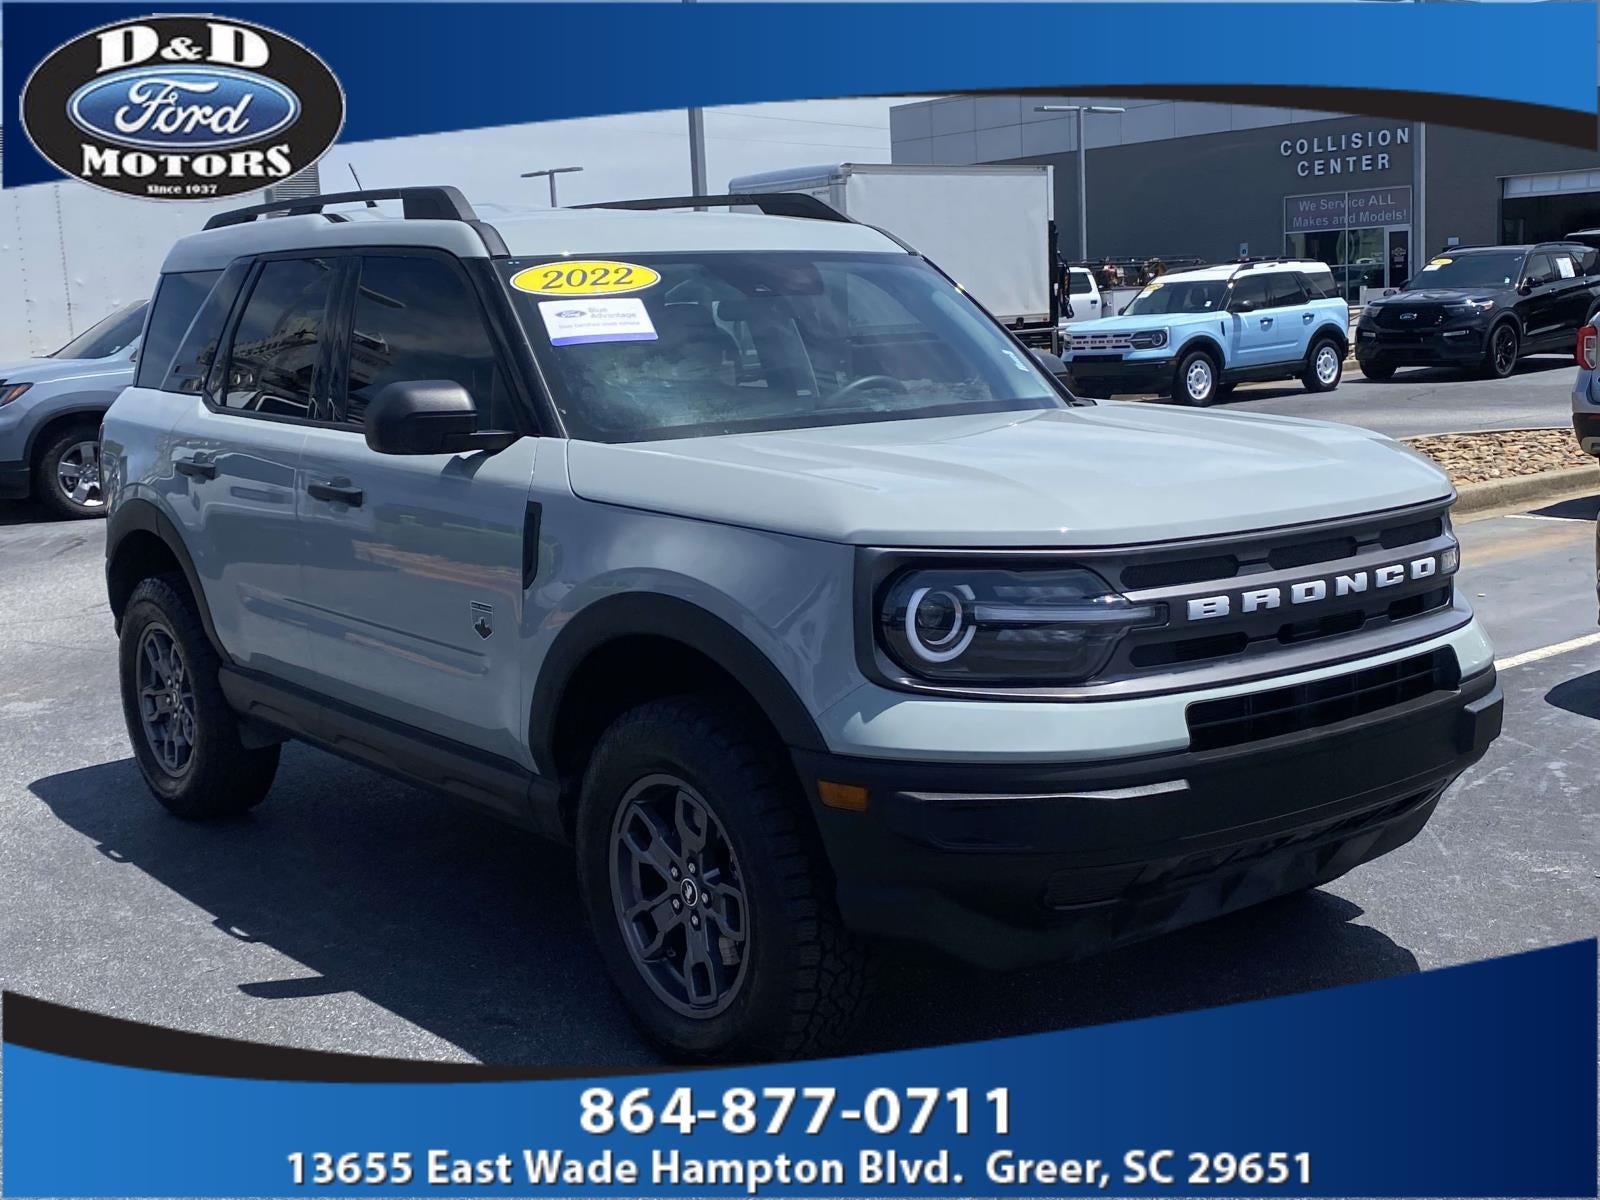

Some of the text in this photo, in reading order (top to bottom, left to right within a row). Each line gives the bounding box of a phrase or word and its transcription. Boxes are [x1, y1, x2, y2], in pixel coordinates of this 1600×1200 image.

[1280, 127, 1409, 156] COLLISION
[1297, 153, 1390, 176] CENTER
[1299, 193, 1396, 212] We Service ALL
[1293, 209, 1407, 228] Makes and Models!
[541, 267, 634, 290] 2022
[1187, 556, 1436, 621] BRONCO
